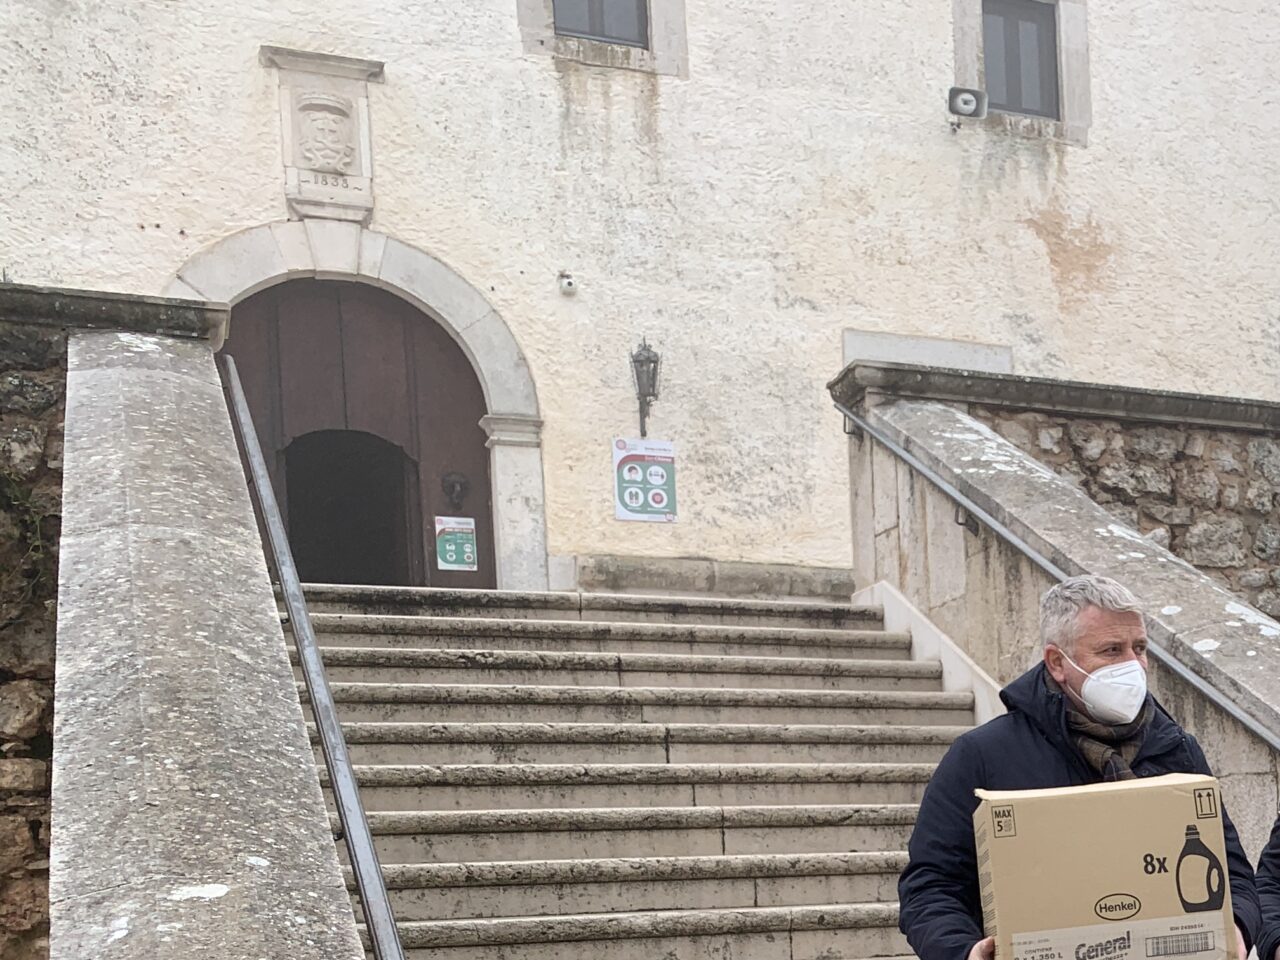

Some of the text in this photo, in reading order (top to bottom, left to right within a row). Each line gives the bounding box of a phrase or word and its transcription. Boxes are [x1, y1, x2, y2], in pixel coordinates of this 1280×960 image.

[994, 809, 1012, 819] MAX
[997, 820, 1004, 832] 5
[1143, 853, 1169, 875] 8x
[1099, 900, 1137, 913] Henkel
